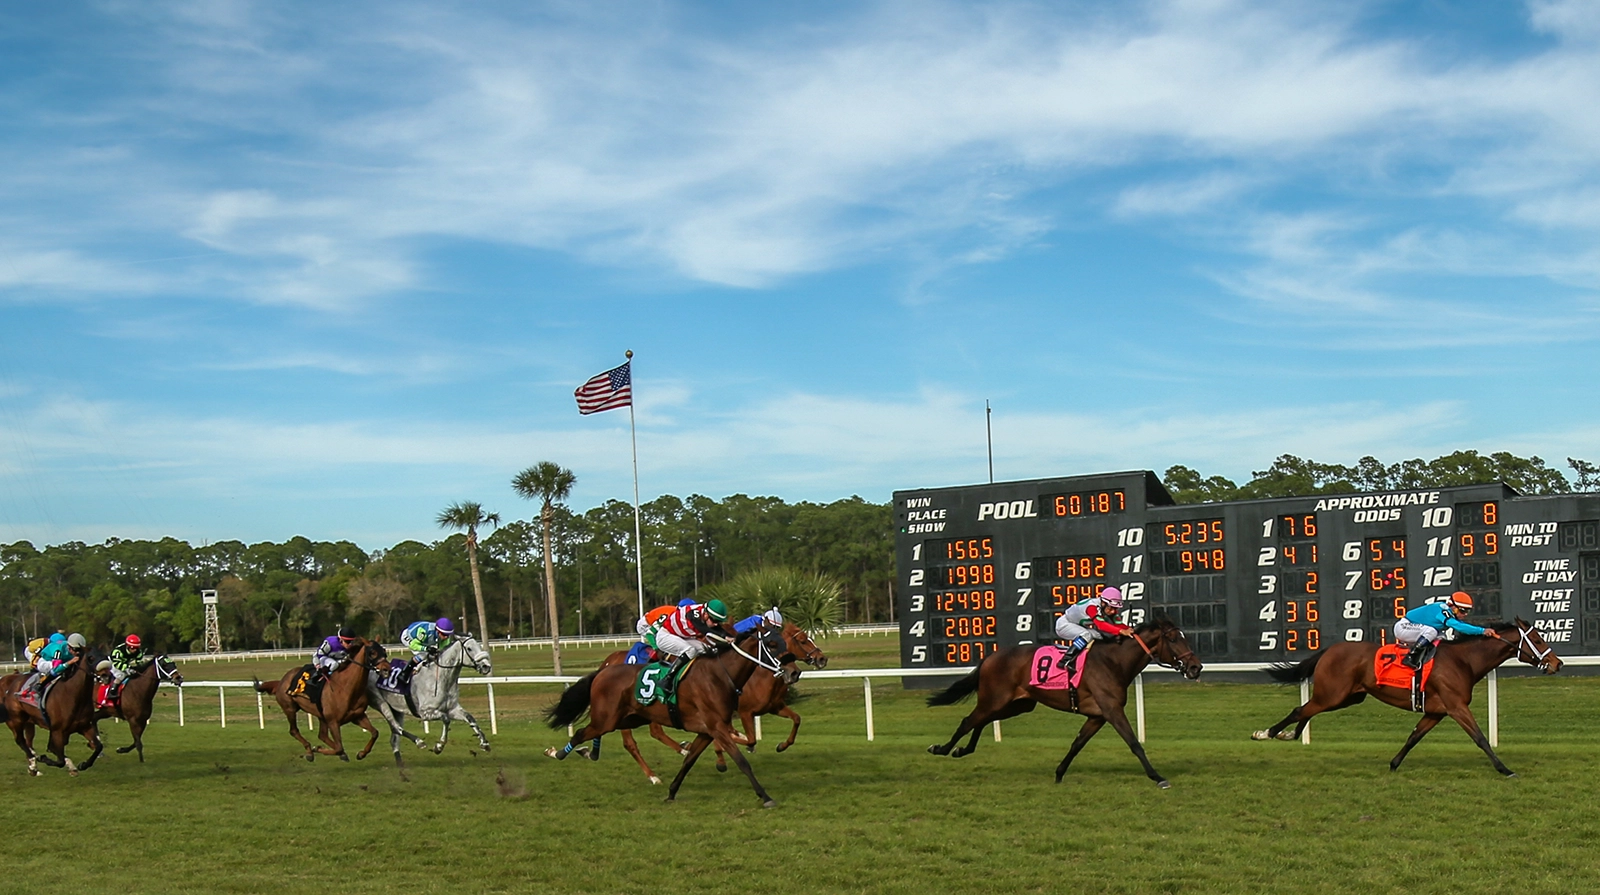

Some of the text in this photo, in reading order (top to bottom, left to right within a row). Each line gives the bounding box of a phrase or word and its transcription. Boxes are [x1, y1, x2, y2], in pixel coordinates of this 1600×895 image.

[907, 498, 931, 508] WIN
[978, 500, 1037, 521] POOL
[1055, 492, 1124, 515] 60187
[1314, 493, 1440, 511] APPROXIMATE
[908, 509, 946, 521] PLACE
[1354, 508, 1401, 523] ODDS
[1422, 507, 1453, 528] 10
[1484, 503, 1496, 525] 8
[908, 522, 946, 534] SHOW
[1117, 527, 1144, 547] 10
[1263, 519, 1274, 537] 1
[1504, 522, 1557, 535] MIN TO
[1426, 536, 1452, 557] 11
[1511, 534, 1553, 547] POST
[912, 543, 922, 561] 1
[1181, 549, 1224, 571] 948
[1257, 547, 1277, 566] 2
[1342, 541, 1362, 561] 6
[1014, 562, 1032, 579] 6
[1057, 557, 1105, 578] 1382
[1121, 555, 1143, 573] 11
[1533, 559, 1570, 571] TIME
[909, 569, 924, 586] 2
[948, 564, 994, 584] 1998
[1306, 572, 1317, 593] 2
[1344, 571, 1363, 590] 7
[1423, 566, 1454, 587] 12
[1522, 570, 1578, 584] OF DAY
[1119, 582, 1145, 600] 12
[1258, 575, 1277, 594] 3
[909, 595, 925, 612] 3
[936, 590, 995, 612] 12498
[1016, 588, 1032, 606] 7
[1530, 589, 1575, 601] POST
[1259, 600, 1277, 622] 4
[1342, 600, 1363, 619] 8
[1394, 597, 1406, 619] 6
[1535, 601, 1571, 613] TIME
[908, 620, 925, 637] 4
[945, 616, 996, 637] 2082
[1016, 614, 1032, 632] 8
[1534, 619, 1575, 631] RACE
[1259, 631, 1278, 650] 5
[911, 645, 927, 662] 5
[1037, 655, 1053, 683] 8
[639, 668, 660, 698] 5
